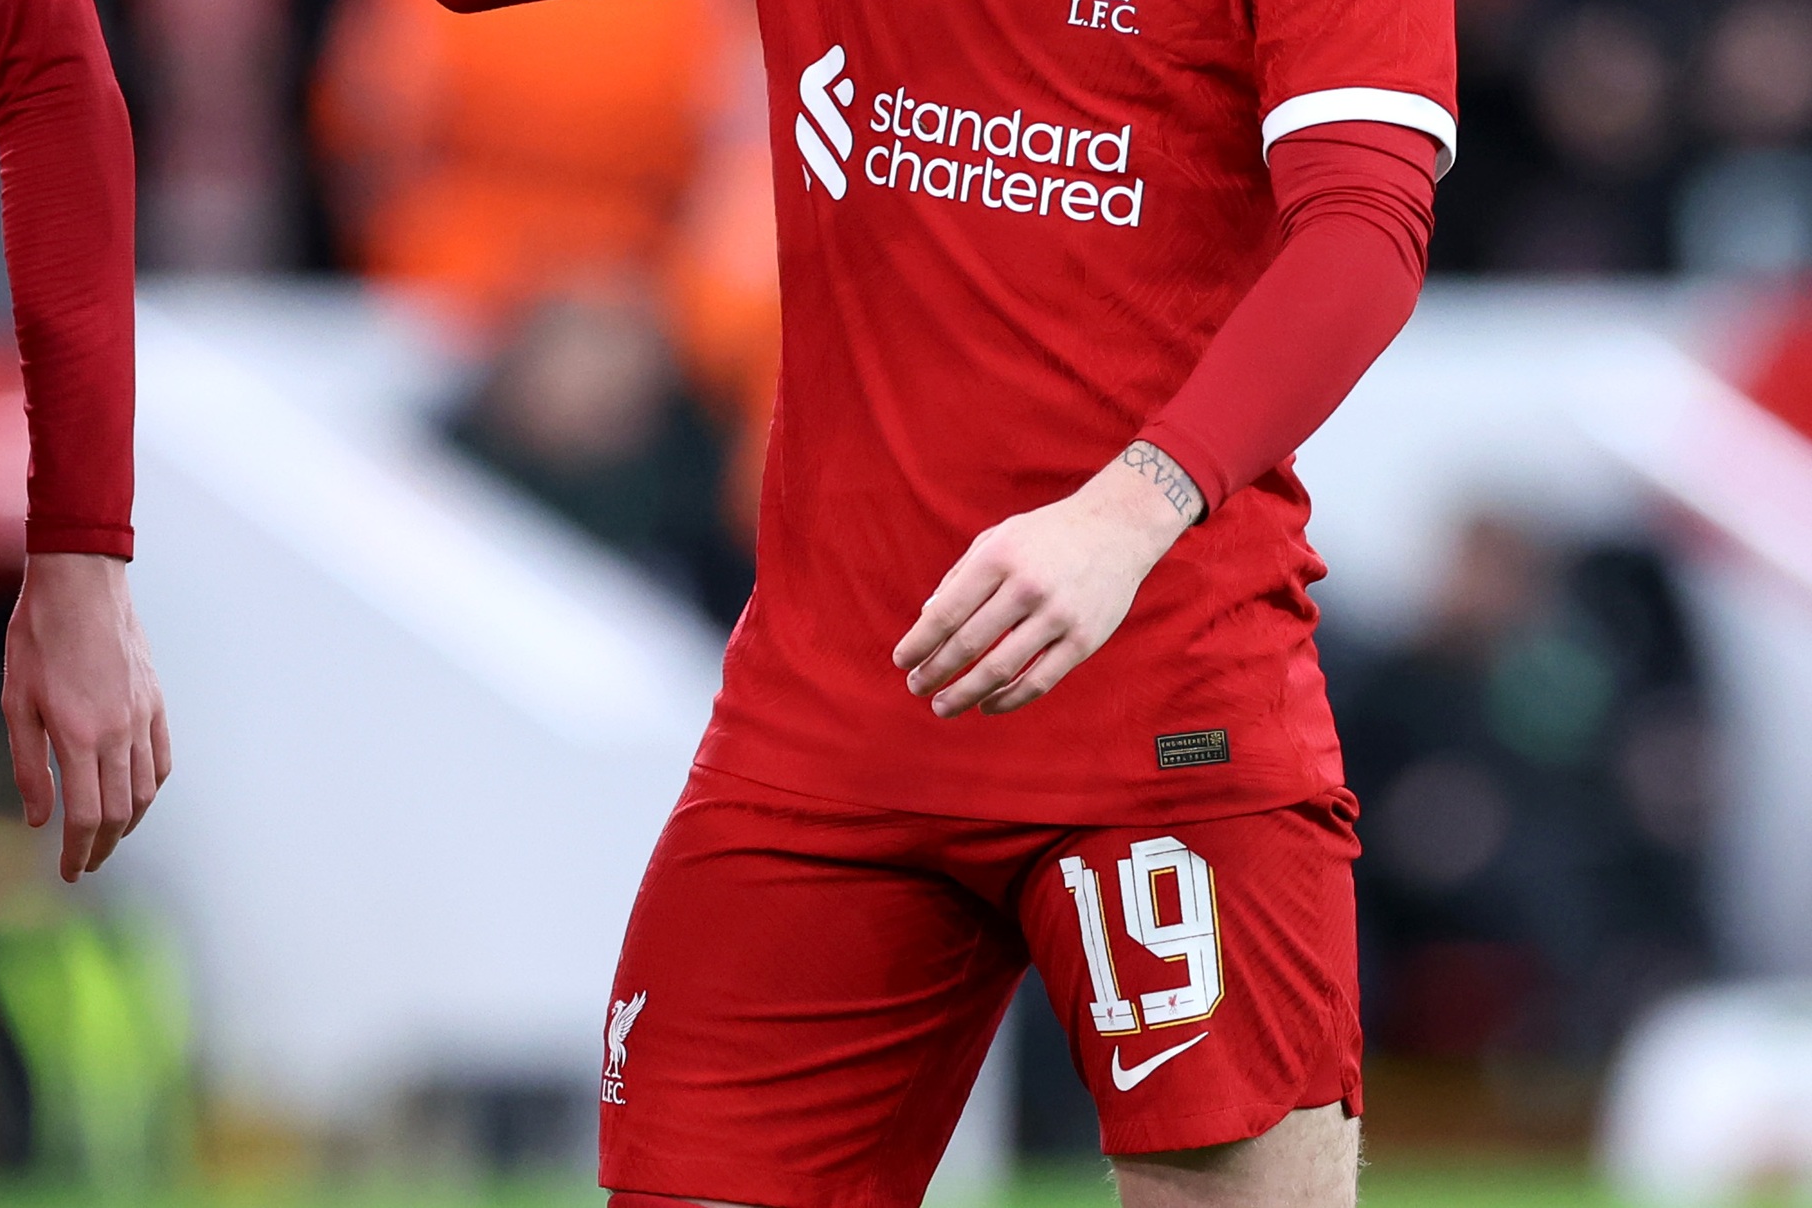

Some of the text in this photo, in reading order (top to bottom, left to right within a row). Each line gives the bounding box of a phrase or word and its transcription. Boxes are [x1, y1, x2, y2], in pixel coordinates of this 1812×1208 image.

[870, 86, 1131, 173] standard
[865, 138, 1144, 227] chartered
[1059, 835, 1225, 1037] 19
